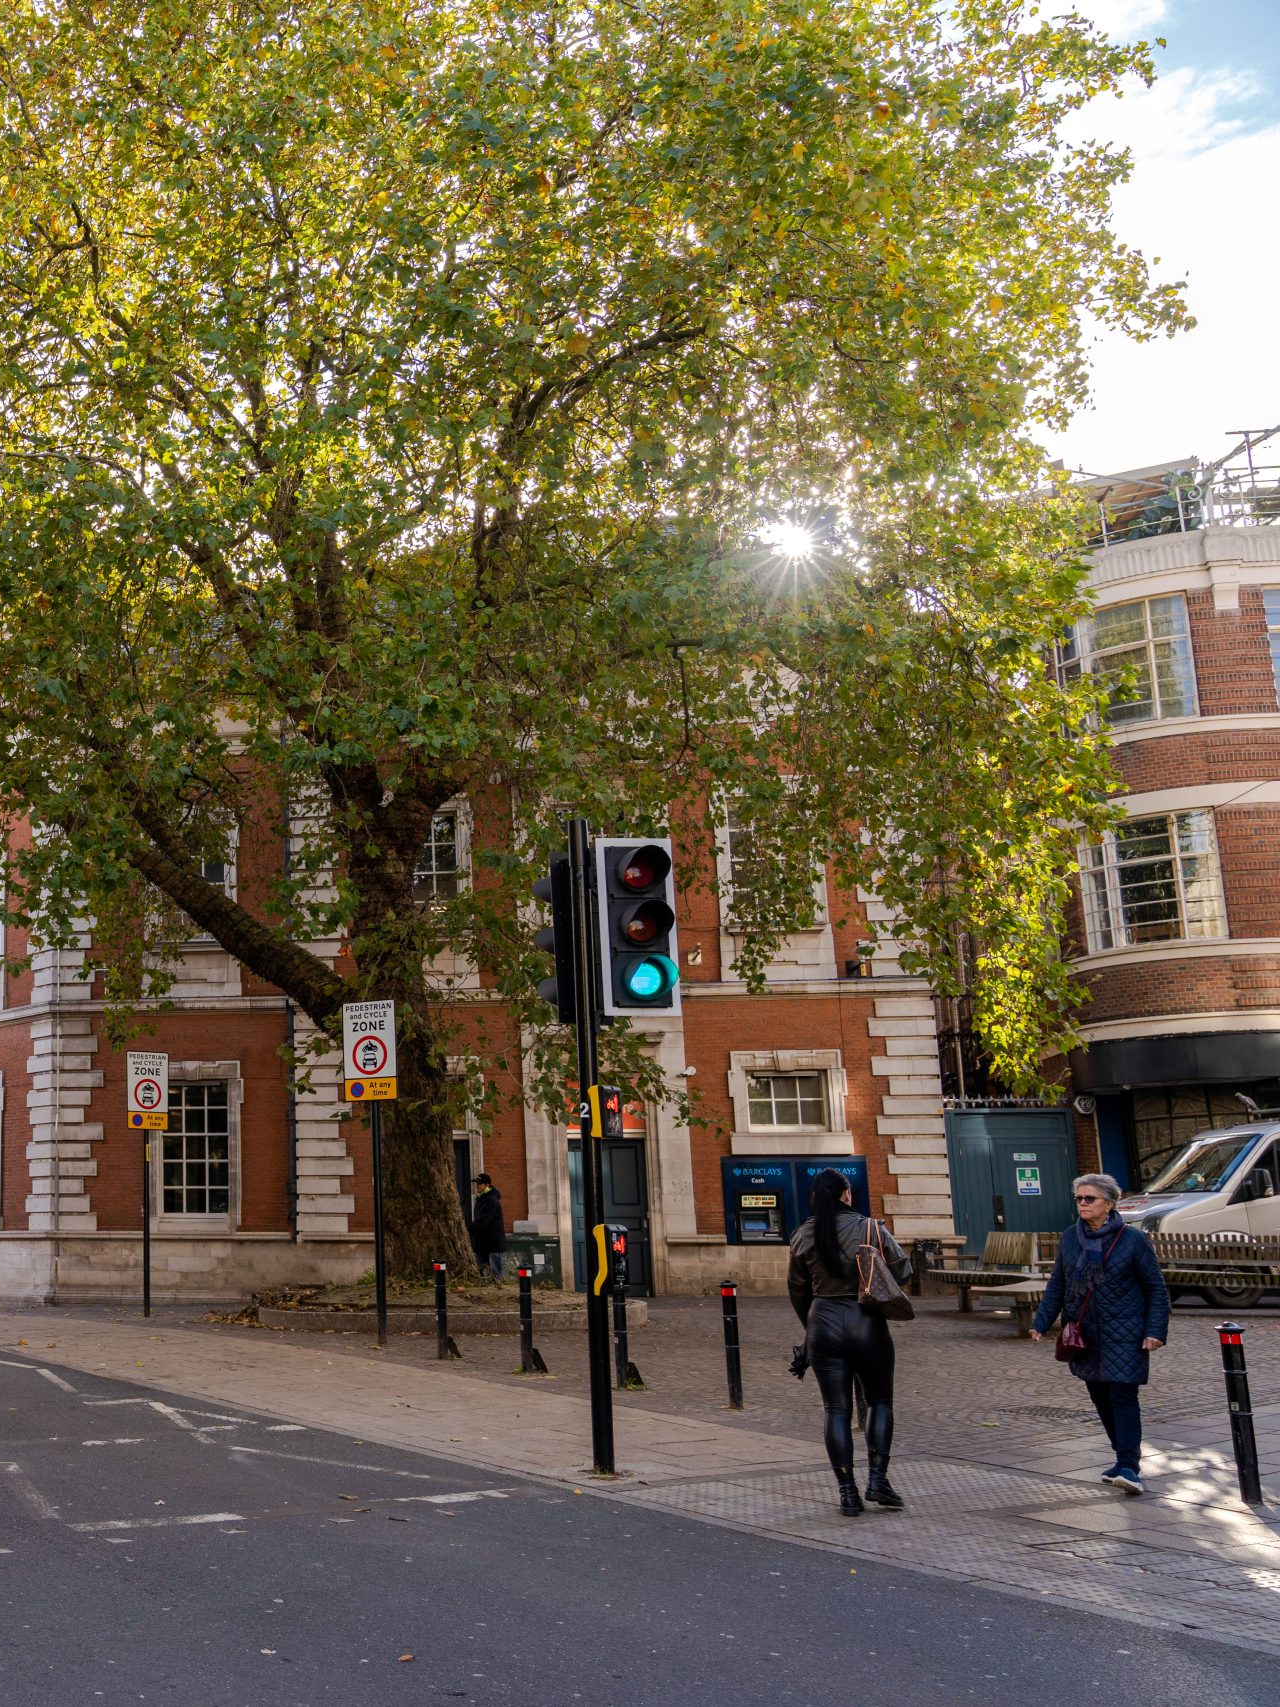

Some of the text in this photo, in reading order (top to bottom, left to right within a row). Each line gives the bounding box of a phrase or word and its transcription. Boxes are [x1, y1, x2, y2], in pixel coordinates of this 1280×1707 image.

[345, 1003, 392, 1013] PEDESTRIAN
[363, 1010, 388, 1019] CYCLE
[352, 1020, 386, 1032] ZONE
[134, 1067, 161, 1076] ZONE
[580, 1102, 590, 1118] 2
[742, 1167, 782, 1176] BARCLAYS
